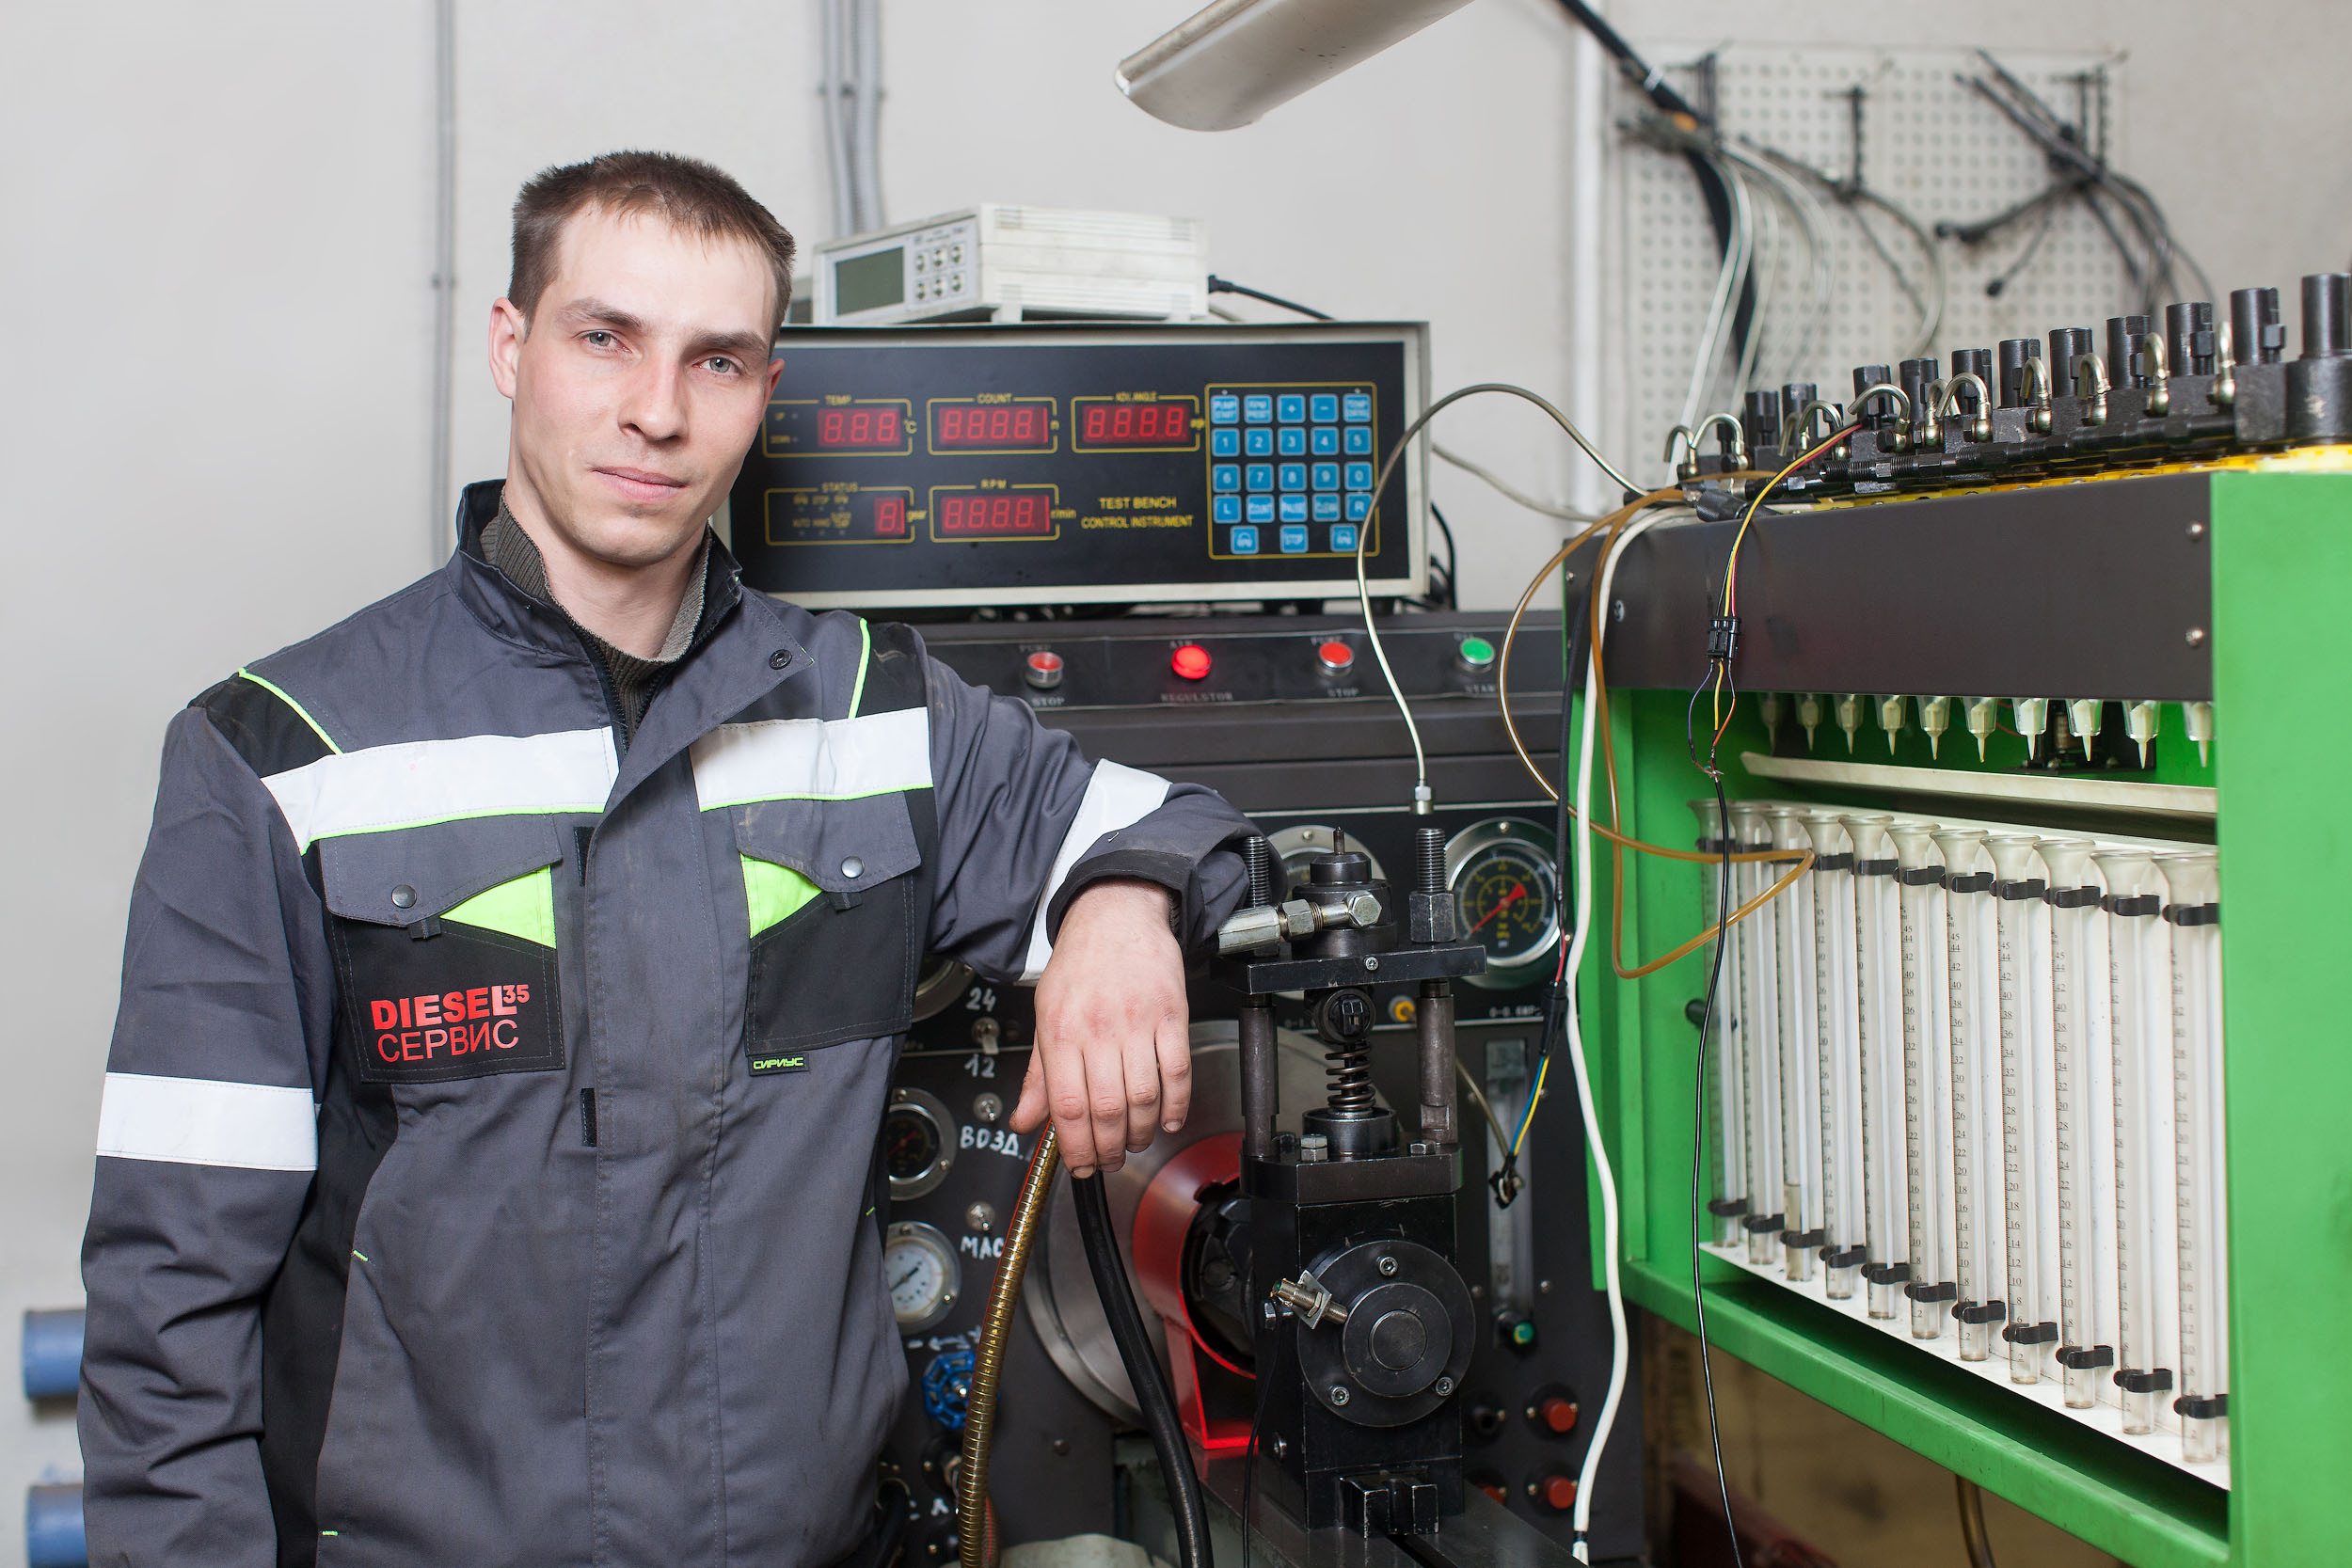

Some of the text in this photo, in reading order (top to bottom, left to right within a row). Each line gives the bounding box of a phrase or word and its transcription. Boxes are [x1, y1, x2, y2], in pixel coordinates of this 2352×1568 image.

[825, 395, 851, 405] TEMP
[977, 393, 1011, 404] COUNT
[1223, 436, 1228, 447] 1
[1255, 436, 1263, 448] 2
[1288, 436, 1296, 448] 3
[1321, 436, 1328, 447] 4
[1257, 471, 1263, 483] 7
[821, 482, 858, 493] STATUS
[980, 479, 1008, 490] RPM
[1099, 496, 1177, 509] TEST BENCH
[1224, 503, 1231, 515] L
[1081, 515, 1194, 529] CONTROL INSTRUMENT
[965, 986, 996, 1013] 24
[371, 984, 530, 1030] DIESEL 35
[377, 1019, 519, 1063] СЕРВИС
[753, 1057, 803, 1070] СИРИУС
[964, 1053, 995, 1078] 12
[2009, 1182, 2019, 1191] 20
[2011, 1259, 2021, 1267] 12
[2016, 1296, 2022, 1305] 8
